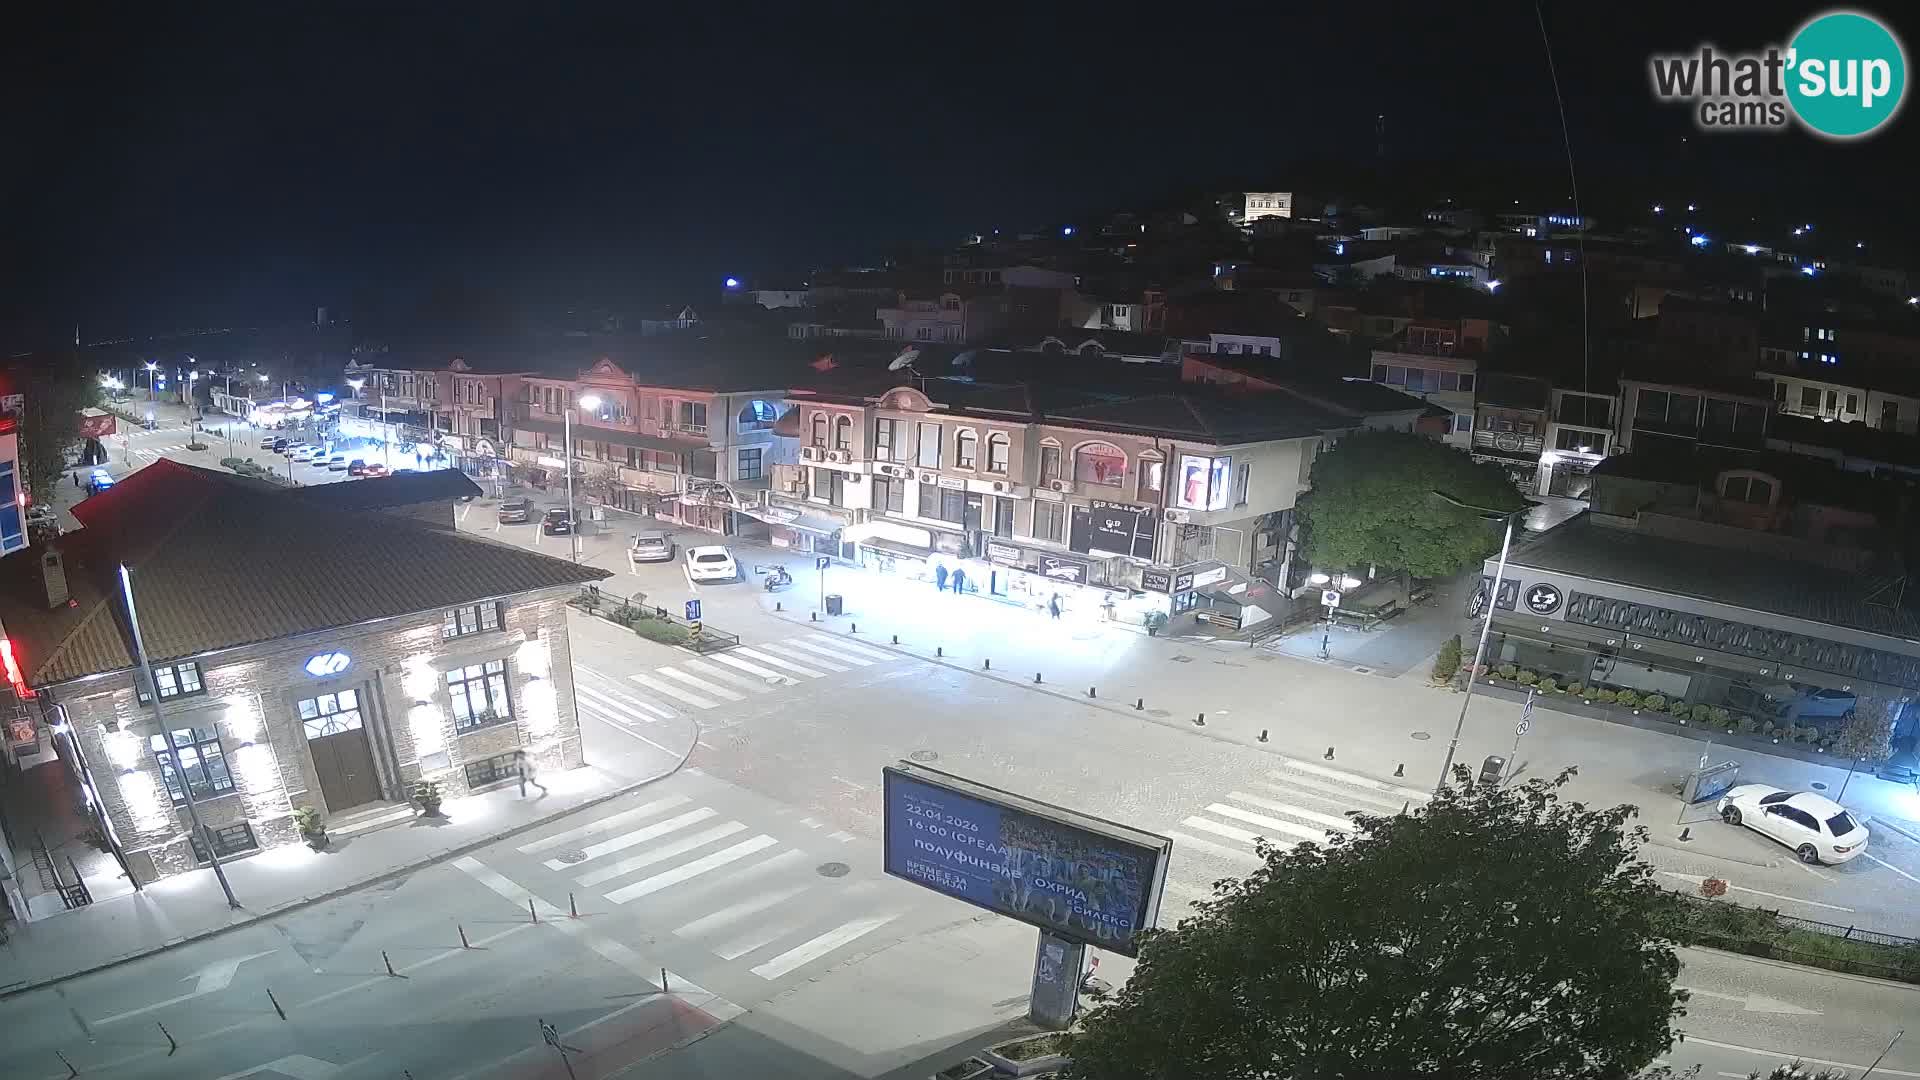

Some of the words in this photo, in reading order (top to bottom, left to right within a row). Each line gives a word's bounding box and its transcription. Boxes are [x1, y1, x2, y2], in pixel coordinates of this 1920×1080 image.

[819, 558, 828, 569] P
[906, 803, 979, 832] 22.04.2026
[907, 818, 947, 837] 16:00
[1034, 878, 1088, 902] ОХРИД
[1073, 905, 1129, 927] СИЛЕКС
